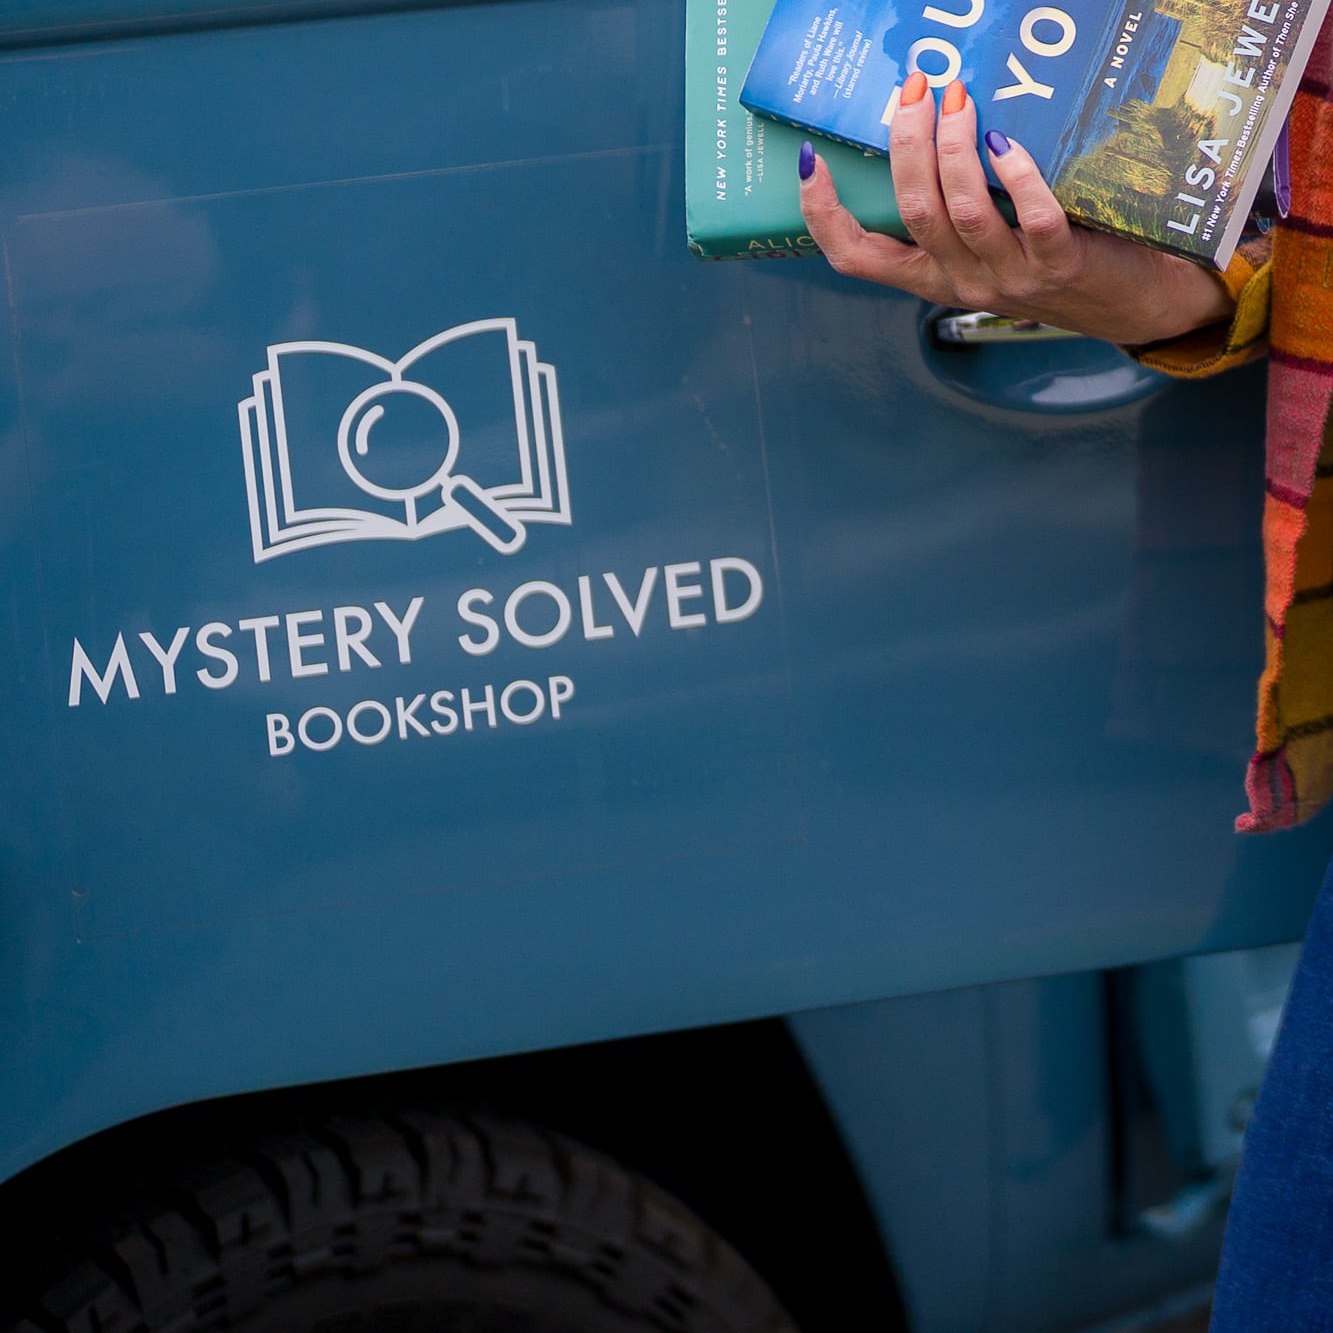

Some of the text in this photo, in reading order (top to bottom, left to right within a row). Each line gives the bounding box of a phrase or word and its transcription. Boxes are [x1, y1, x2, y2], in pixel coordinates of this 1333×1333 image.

[1285, 1, 1299, 21] She
[807, 16, 821, 39] Liane
[1275, 21, 1291, 46] Then
[793, 8, 839, 103] Moriarty, Paula Hawkins,
[804, 39, 813, 49] of
[809, 20, 844, 96] and Ruth Ware will
[847, 30, 864, 61] Journal
[1103, 11, 1143, 89] A NOVEL
[1272, 46, 1282, 58] of
[825, 65, 838, 82] love
[842, 38, 873, 99] (starred review)
[1258, 60, 1278, 94] Author
[716, 65, 728, 112] TIMES
[1237, 95, 1265, 148] Bestselling
[716, 118, 728, 160] YORK
[744, 148, 753, 159] of
[757, 122, 765, 155] JEWELL
[744, 160, 753, 182] work
[1225, 149, 1243, 179] Times
[716, 166, 727, 201] NEW
[1166, 138, 1229, 235] LISA
[1215, 181, 1231, 204] York
[1208, 206, 1223, 228] New
[1201, 227, 1213, 242] #1
[68, 557, 764, 708] MYSTERY SOLVED
[266, 675, 577, 758] BOOKSHOP
